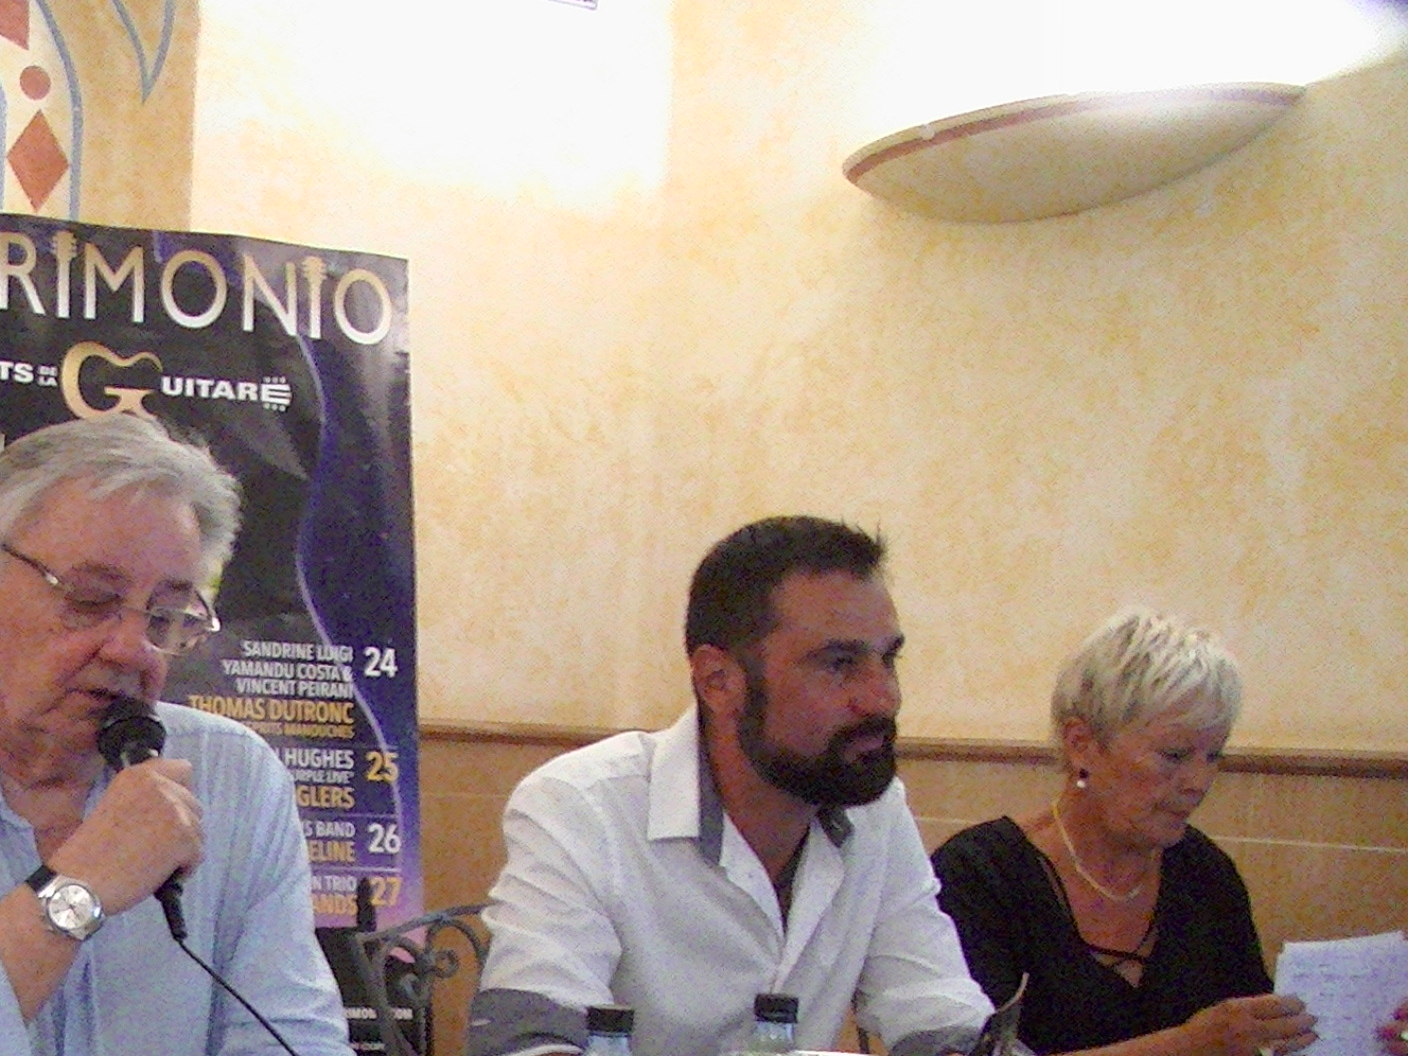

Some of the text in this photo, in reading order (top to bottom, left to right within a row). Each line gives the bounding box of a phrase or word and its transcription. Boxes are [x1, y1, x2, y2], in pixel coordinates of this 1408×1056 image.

[38, 365, 58, 376] DE
[38, 374, 58, 388] LA
[242, 640, 353, 662] SANDRINE LUIGI
[222, 660, 292, 677] YAMANDU
[296, 664, 340, 679] COSTA
[364, 647, 398, 678] 24
[235, 678, 354, 698] VINCENT PEIRANI
[188, 695, 355, 724] THOMAS DUTRONC
[284, 748, 355, 769] HUGHES
[365, 751, 399, 782] 25
[316, 821, 356, 838] BAND
[368, 822, 401, 853] 26
[370, 877, 403, 906] 27
